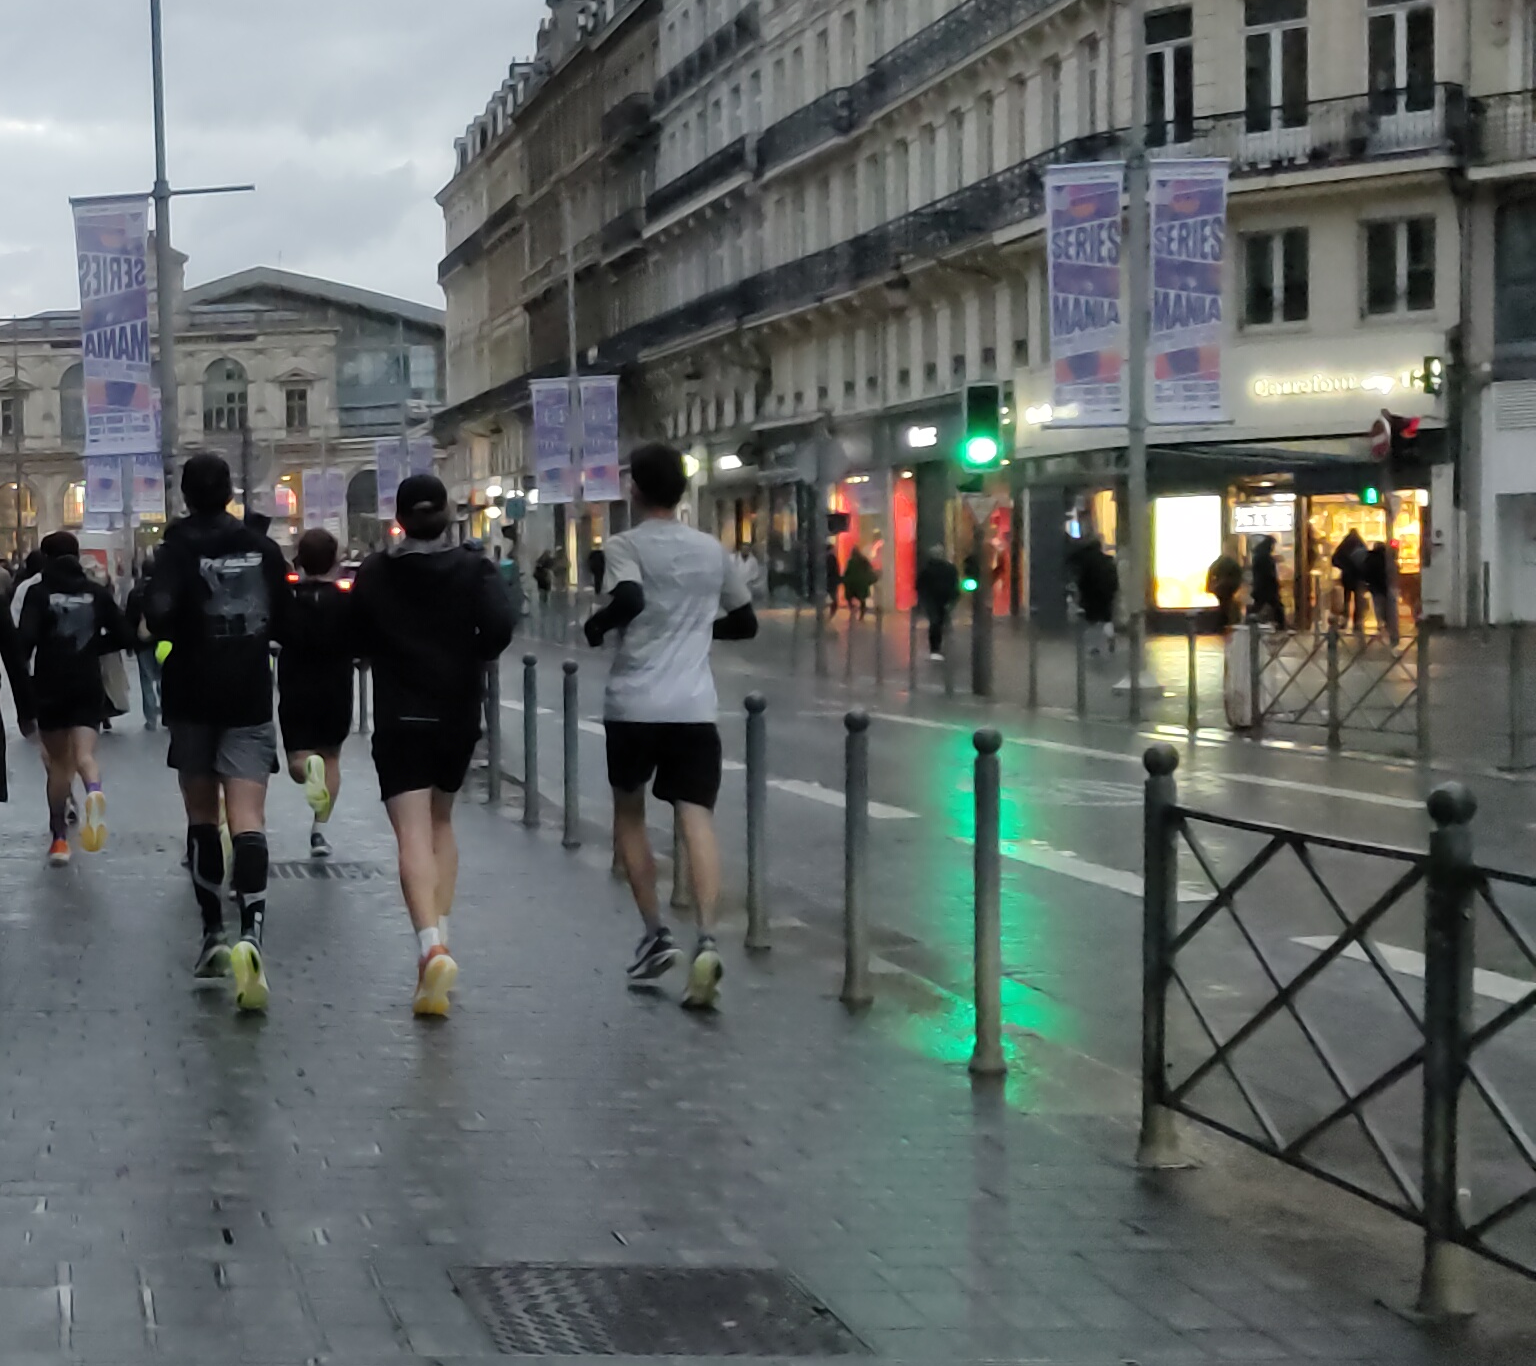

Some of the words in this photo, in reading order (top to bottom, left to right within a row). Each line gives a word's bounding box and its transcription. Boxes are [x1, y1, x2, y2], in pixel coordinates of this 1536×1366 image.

[1052, 219, 1121, 265] SERIES
[1155, 216, 1223, 261] SERIES
[1053, 293, 1121, 335] MANIA
[1155, 290, 1222, 333] MANIA
